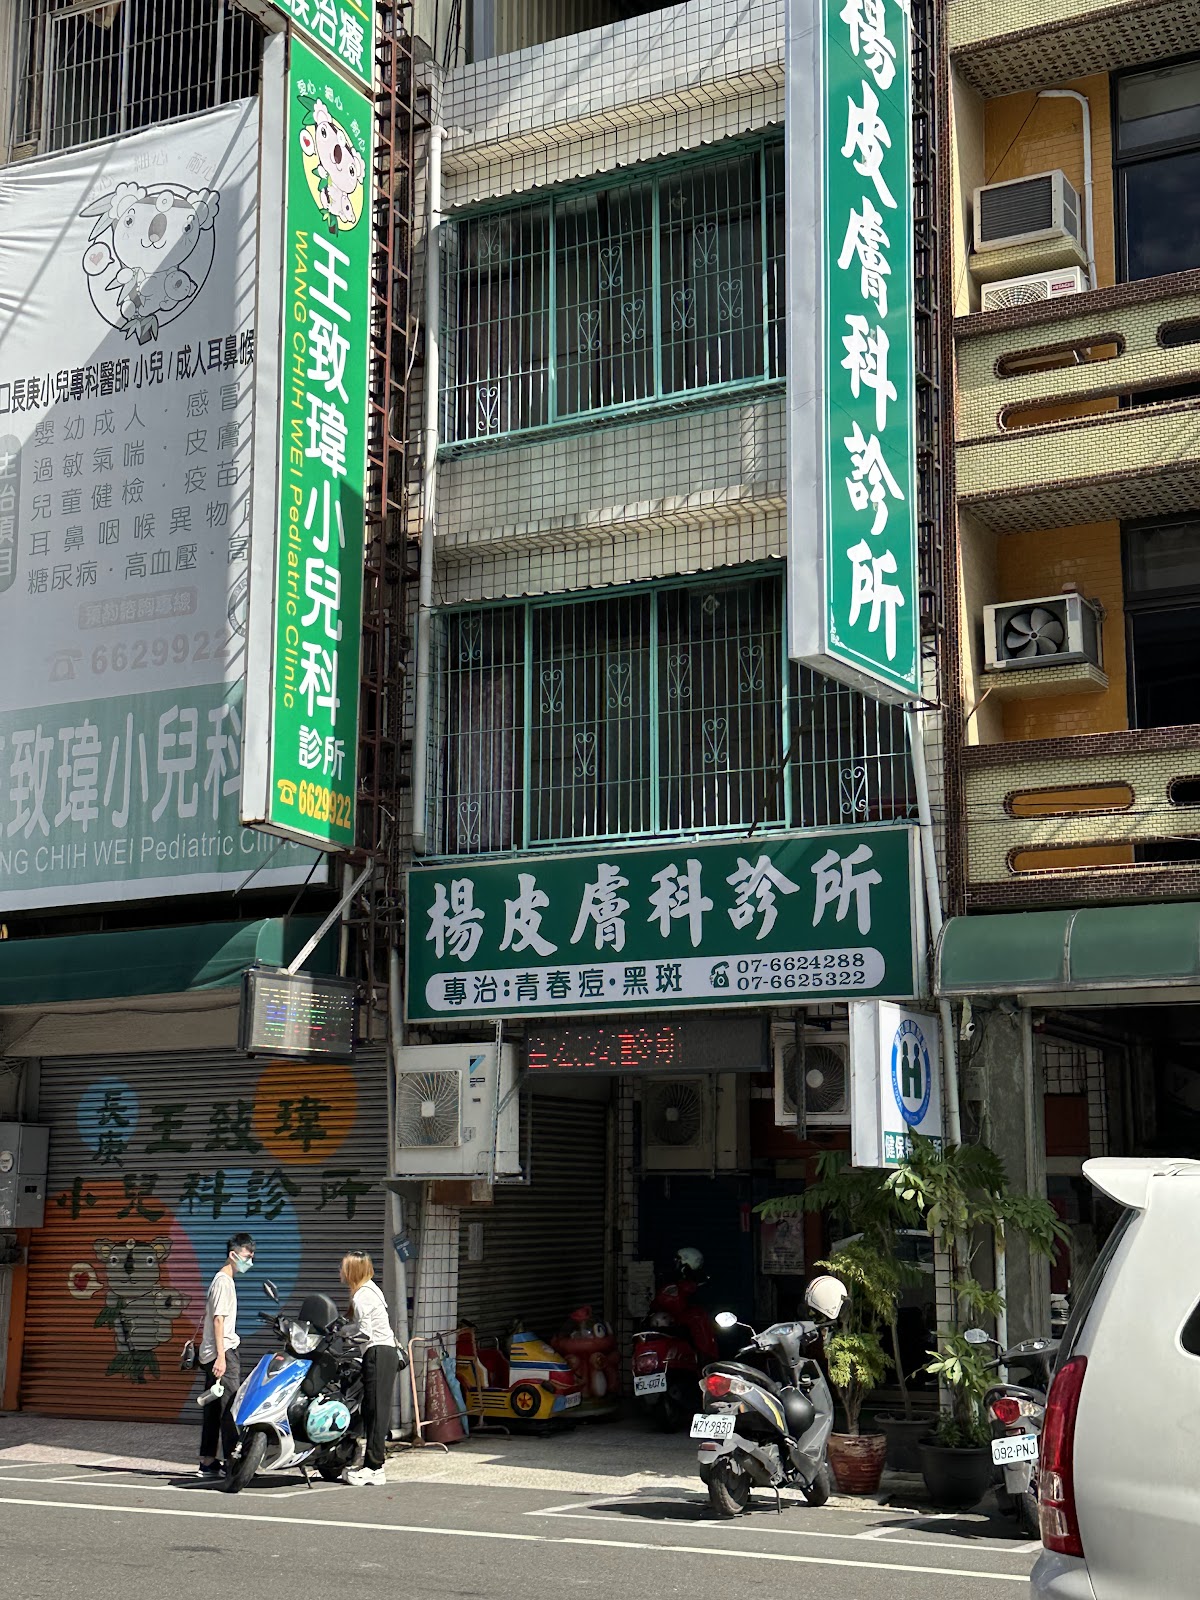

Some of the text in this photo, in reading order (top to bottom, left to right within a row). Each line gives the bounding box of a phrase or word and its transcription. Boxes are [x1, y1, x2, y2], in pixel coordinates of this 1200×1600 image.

[836, 0, 905, 661] 楊皮膚科診所
[283, 230, 309, 709] WANG CHIH WEI Pediatric Clinic
[299, 725, 346, 781] 診所
[299, 779, 352, 830] 6629922
[35, 842, 87, 873] CHIH
[94, 838, 134, 867] WEI
[140, 830, 234, 863] Pediatric
[425, 843, 884, 963] 楊皮膚科診所
[736, 952, 866, 973] 07-6624288
[737, 970, 867, 991] 07-6625322
[57, 1167, 373, 1221] 小兒科診所
